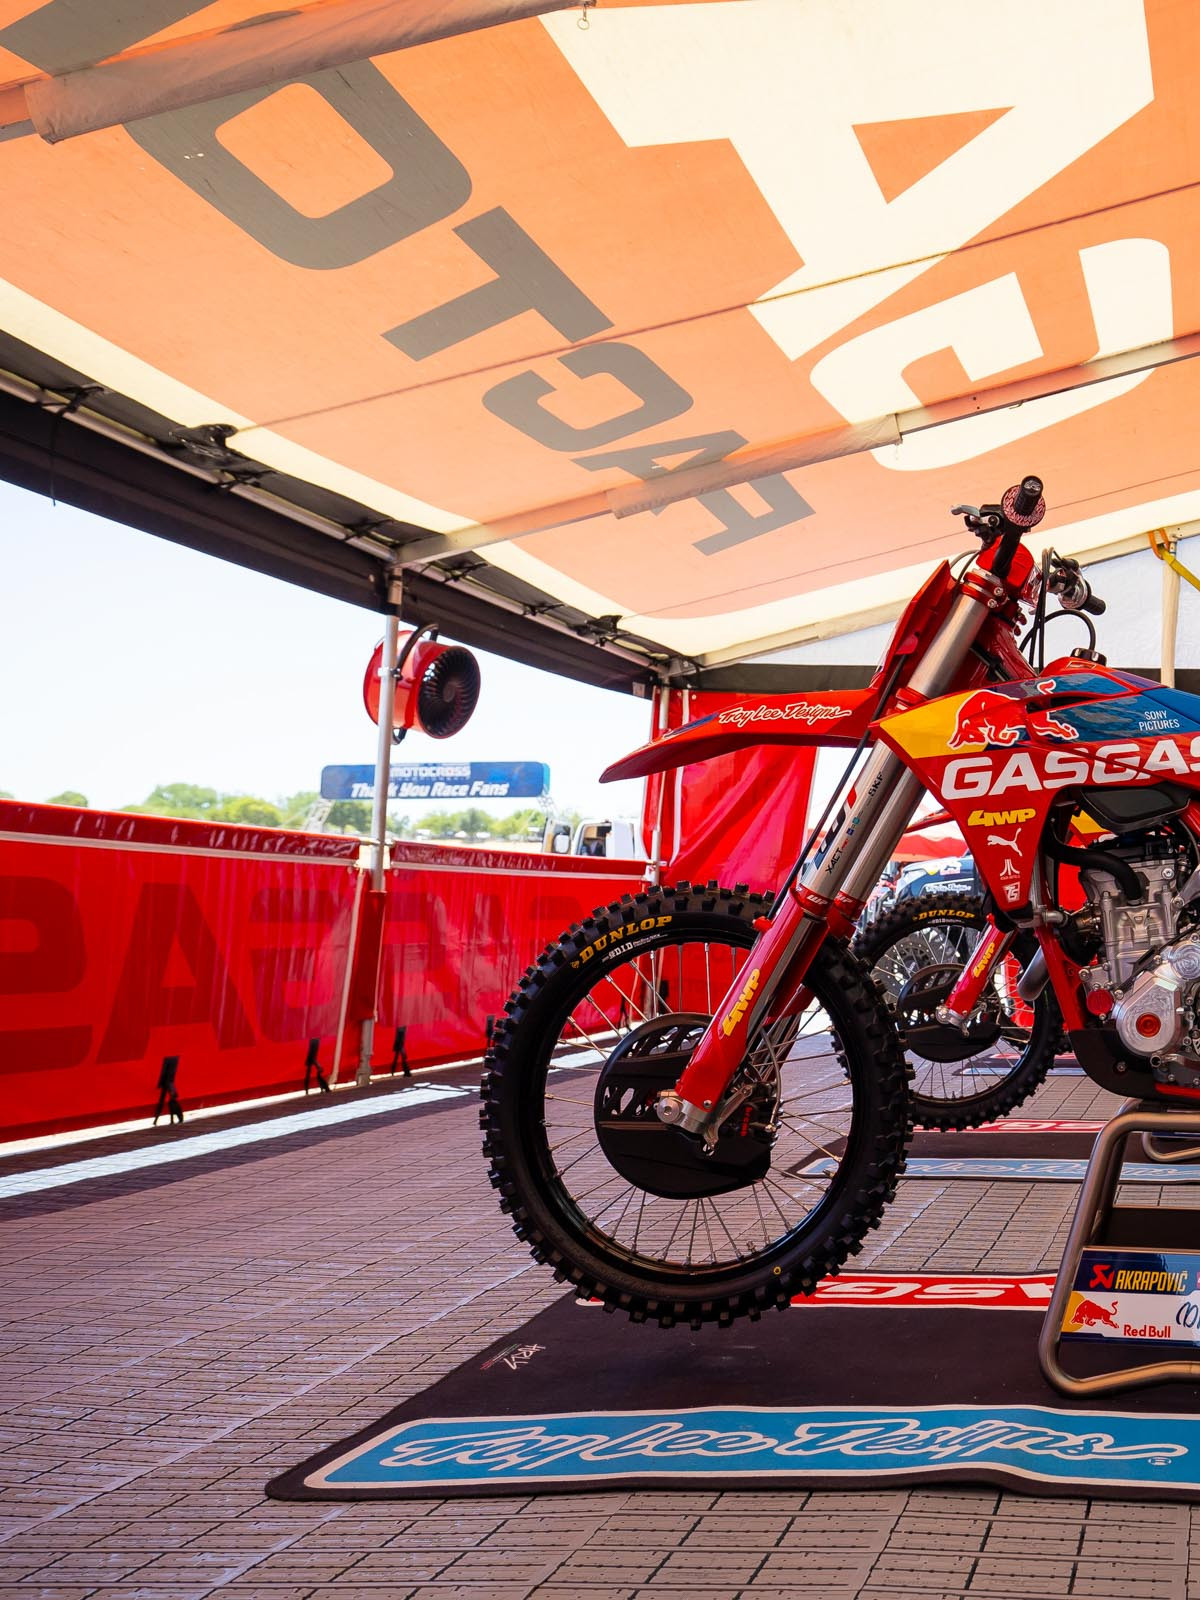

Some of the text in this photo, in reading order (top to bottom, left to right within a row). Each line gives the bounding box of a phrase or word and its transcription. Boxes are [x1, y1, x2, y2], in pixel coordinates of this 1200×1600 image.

[719, 702, 852, 727] Troy Lee Designs
[1138, 718, 1180, 732] PICTURES
[1144, 710, 1167, 721] SONY
[399, 781, 430, 797] You
[430, 781, 469, 797] Race
[470, 780, 510, 797] Fans
[868, 771, 883, 797] SKF
[825, 847, 842, 875] XACT
[918, 909, 975, 920] DUNLOP
[579, 915, 673, 964] DUNLOP
[1123, 1324, 1171, 1339] Red Bull
[580, 1421, 778, 1461] Lee
[776, 1417, 1189, 1461] Designs
